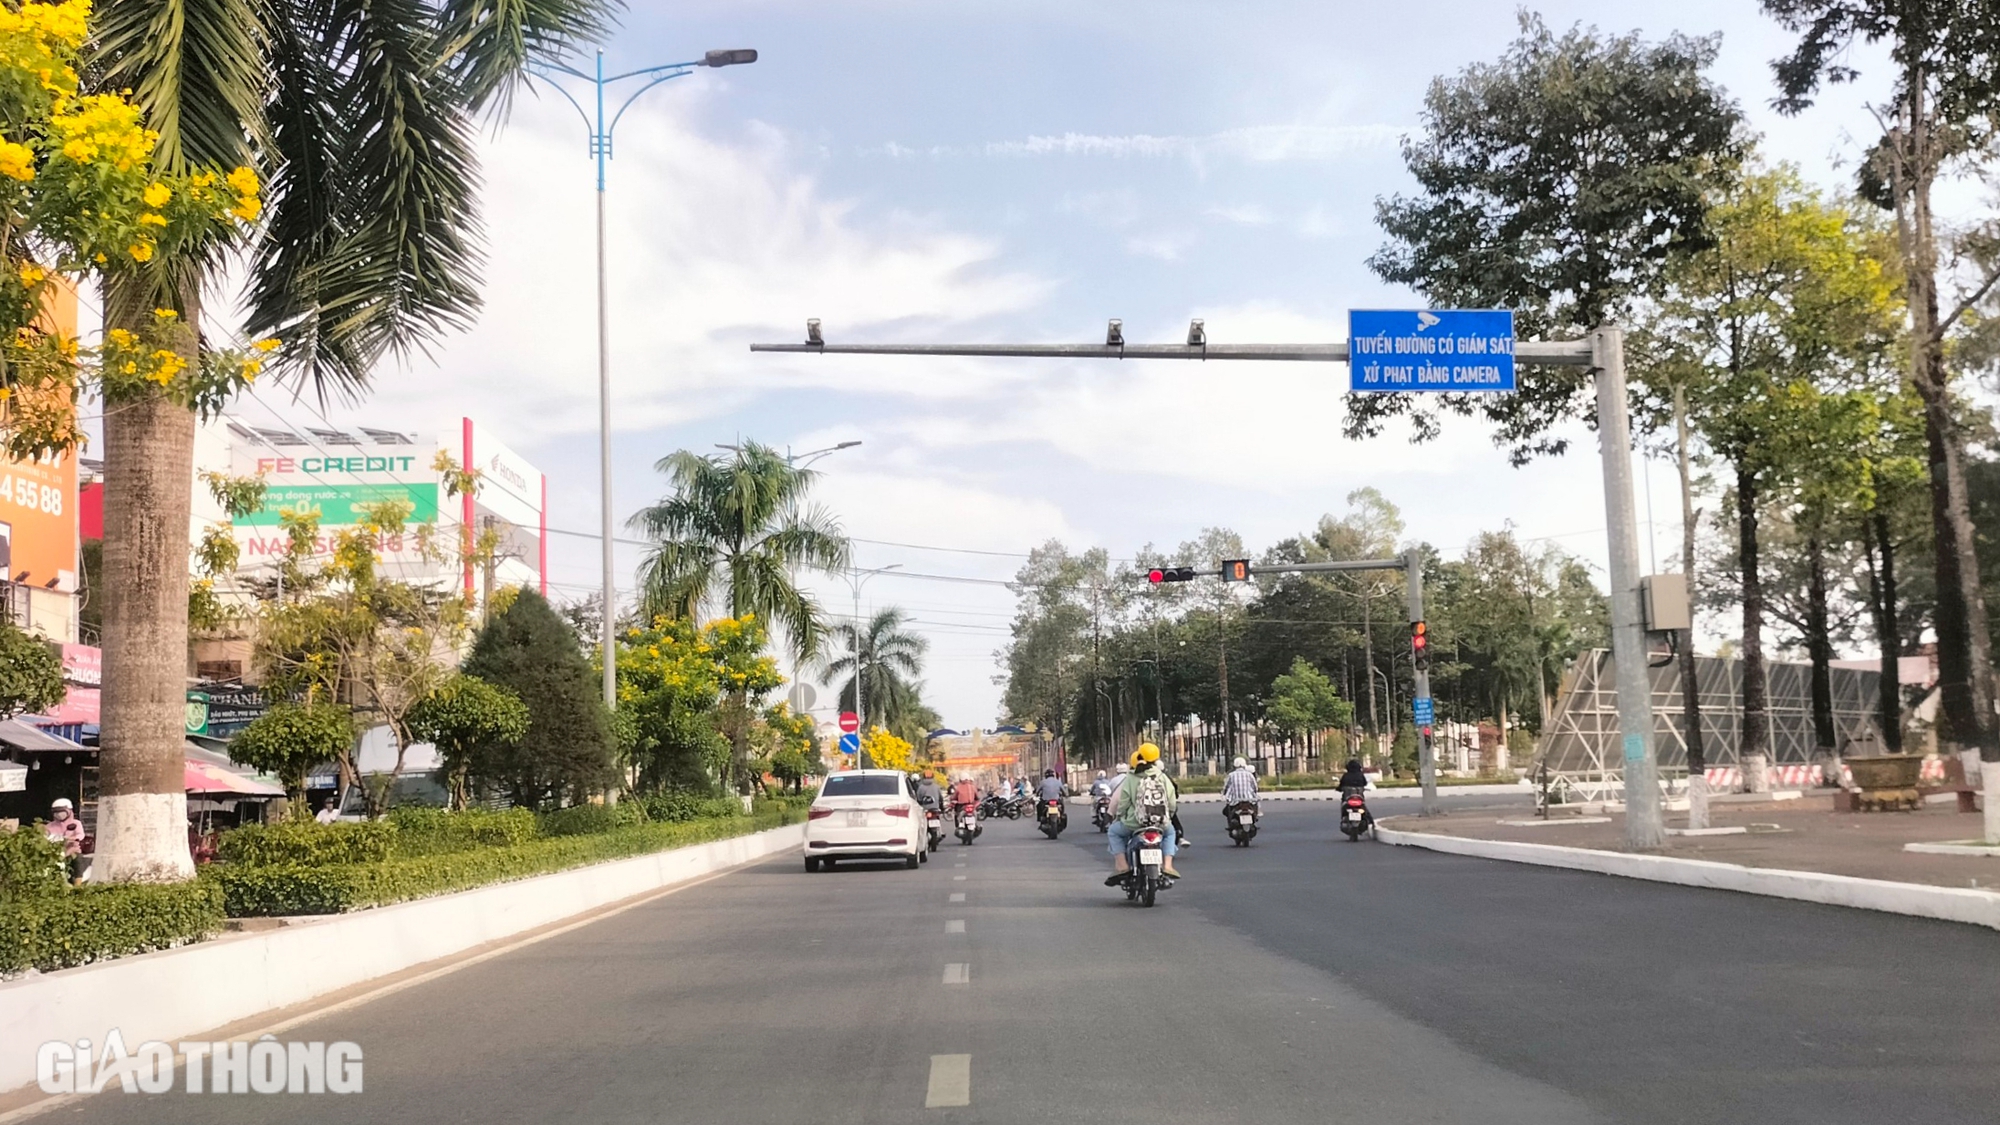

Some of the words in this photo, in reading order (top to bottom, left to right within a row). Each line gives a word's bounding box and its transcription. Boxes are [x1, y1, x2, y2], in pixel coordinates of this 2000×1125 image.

[1355, 330, 1392, 354] TUYẾN
[1395, 333, 1435, 354] ĐƯỜNG
[1438, 333, 1454, 354] CÓ
[1457, 333, 1487, 354] GIÁM
[1363, 360, 1380, 383] XỬ
[1384, 366, 1413, 386] PHẠT
[1418, 359, 1449, 383] BẰNG
[1453, 366, 1500, 383] CAMERA
[257, 458, 294, 473] FE
[302, 457, 415, 473] CREDIT
[500, 461, 527, 493] HONDA
[15, 477, 38, 509] 55
[40, 484, 62, 516] 88
[210, 692, 263, 705] THANH
